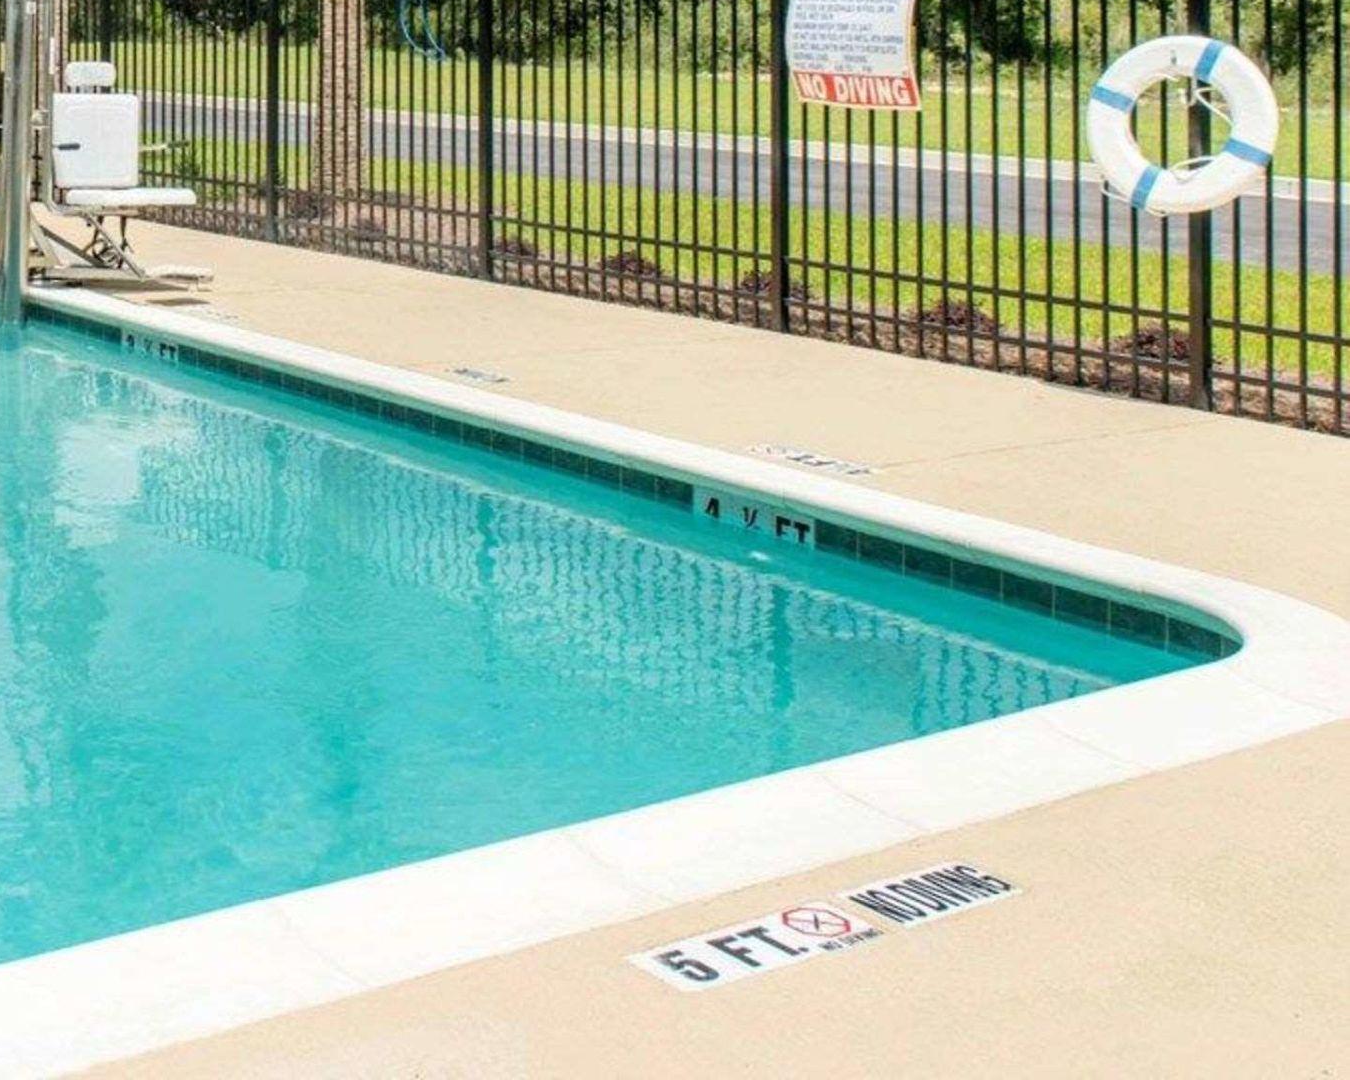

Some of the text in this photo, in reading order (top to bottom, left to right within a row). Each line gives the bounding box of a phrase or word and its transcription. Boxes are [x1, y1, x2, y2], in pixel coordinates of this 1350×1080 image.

[797, 73, 911, 104] NO DIVING
[846, 865, 1014, 923] NO DIVING
[657, 925, 809, 982] 5 FT.
